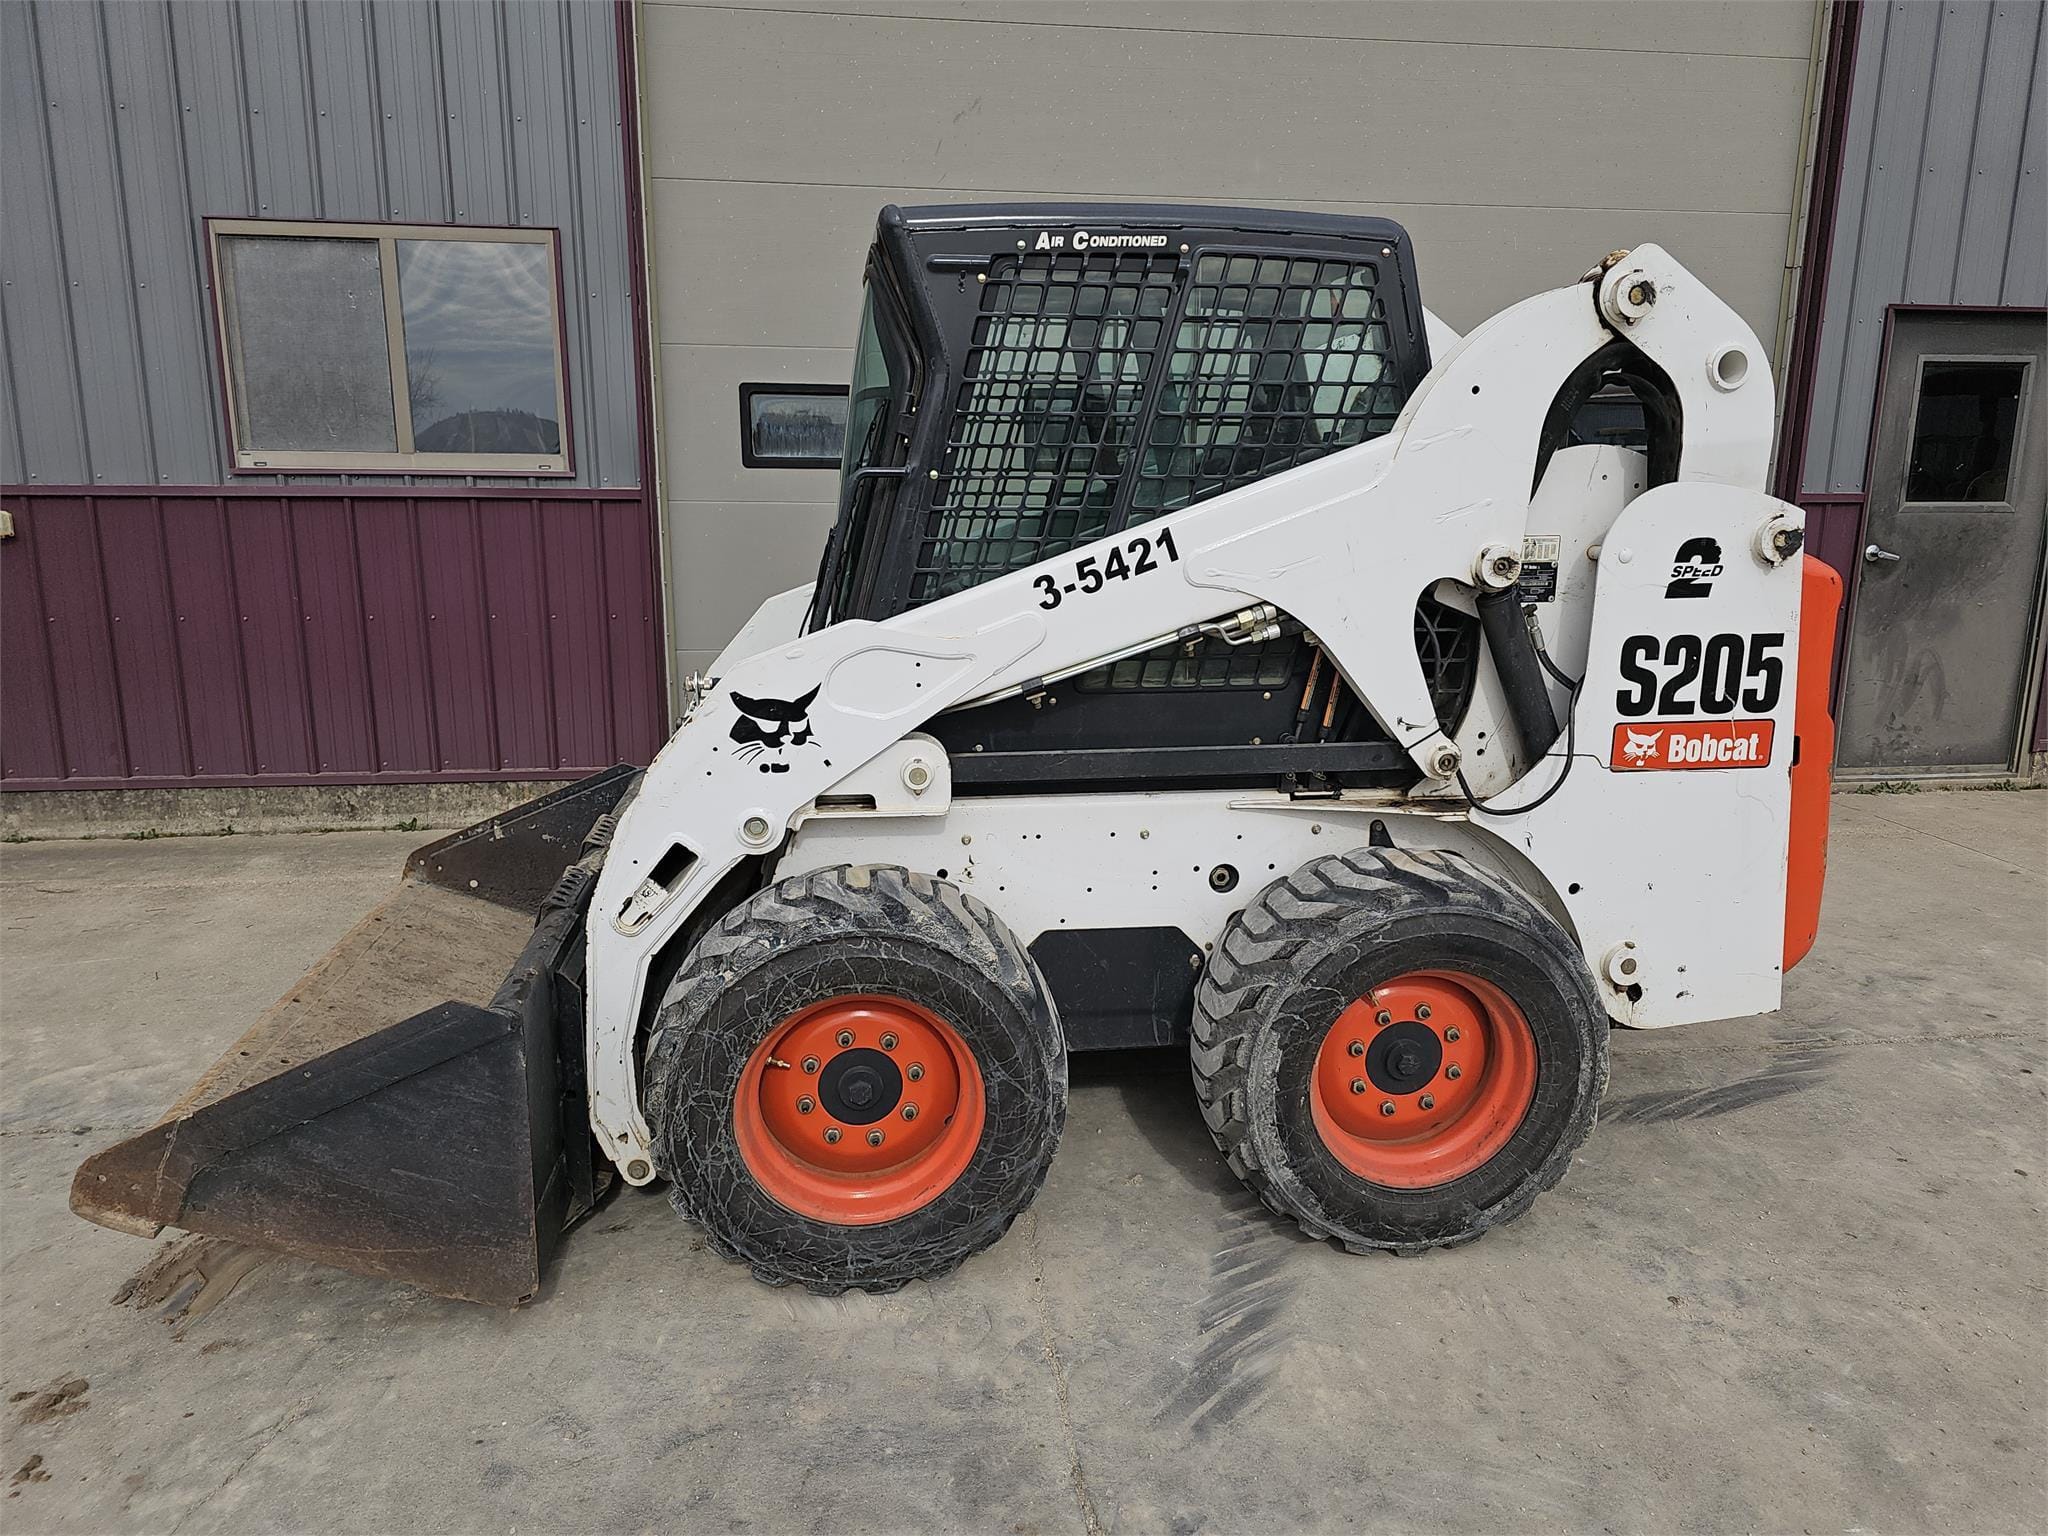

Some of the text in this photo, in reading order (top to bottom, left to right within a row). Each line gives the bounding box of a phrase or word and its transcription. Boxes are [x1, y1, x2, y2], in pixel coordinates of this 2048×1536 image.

[1035, 231, 1168, 250] AIR CONDITIONED
[1033, 527, 1179, 610] 3-5421
[1664, 537, 1722, 599] 2
[1671, 565, 1724, 578] SPEED
[1616, 633, 1785, 716] S205
[1668, 733, 1760, 763] Bobcat
